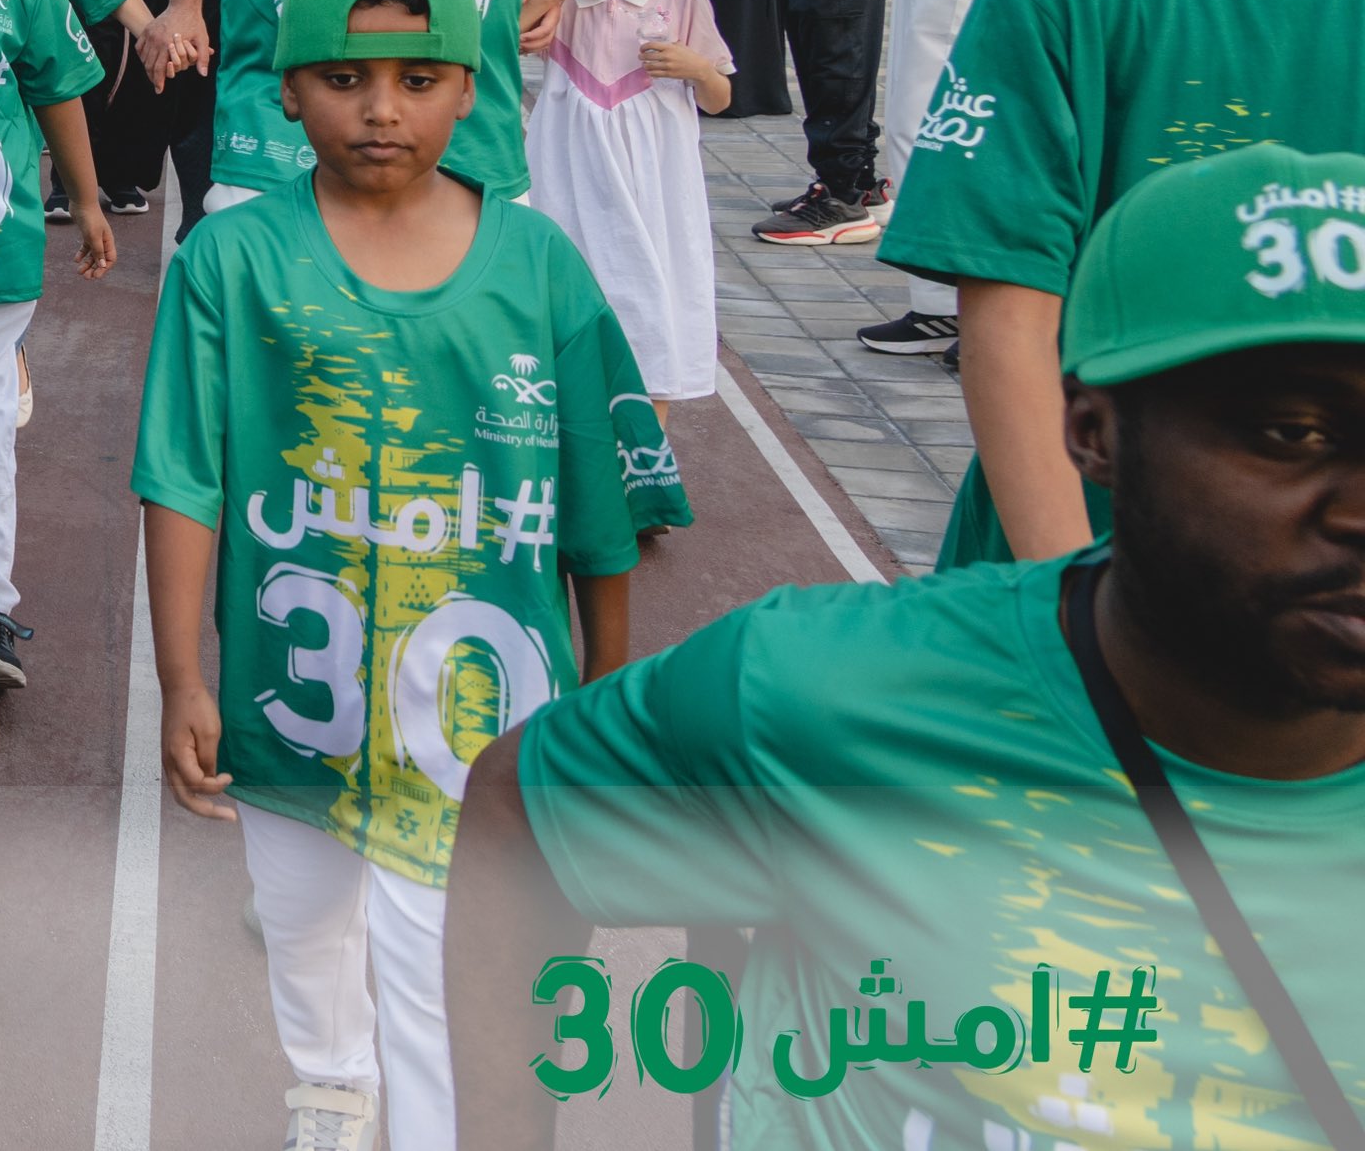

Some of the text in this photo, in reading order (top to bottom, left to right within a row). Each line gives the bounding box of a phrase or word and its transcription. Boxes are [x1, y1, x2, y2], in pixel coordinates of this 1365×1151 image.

[1241, 216, 1365, 300] 30
[474, 427, 521, 446] Ministry
[525, 433, 537, 446] of
[475, 406, 559, 435] زارة الصحة
[246, 447, 556, 571] #امش
[254, 561, 560, 799] 30
